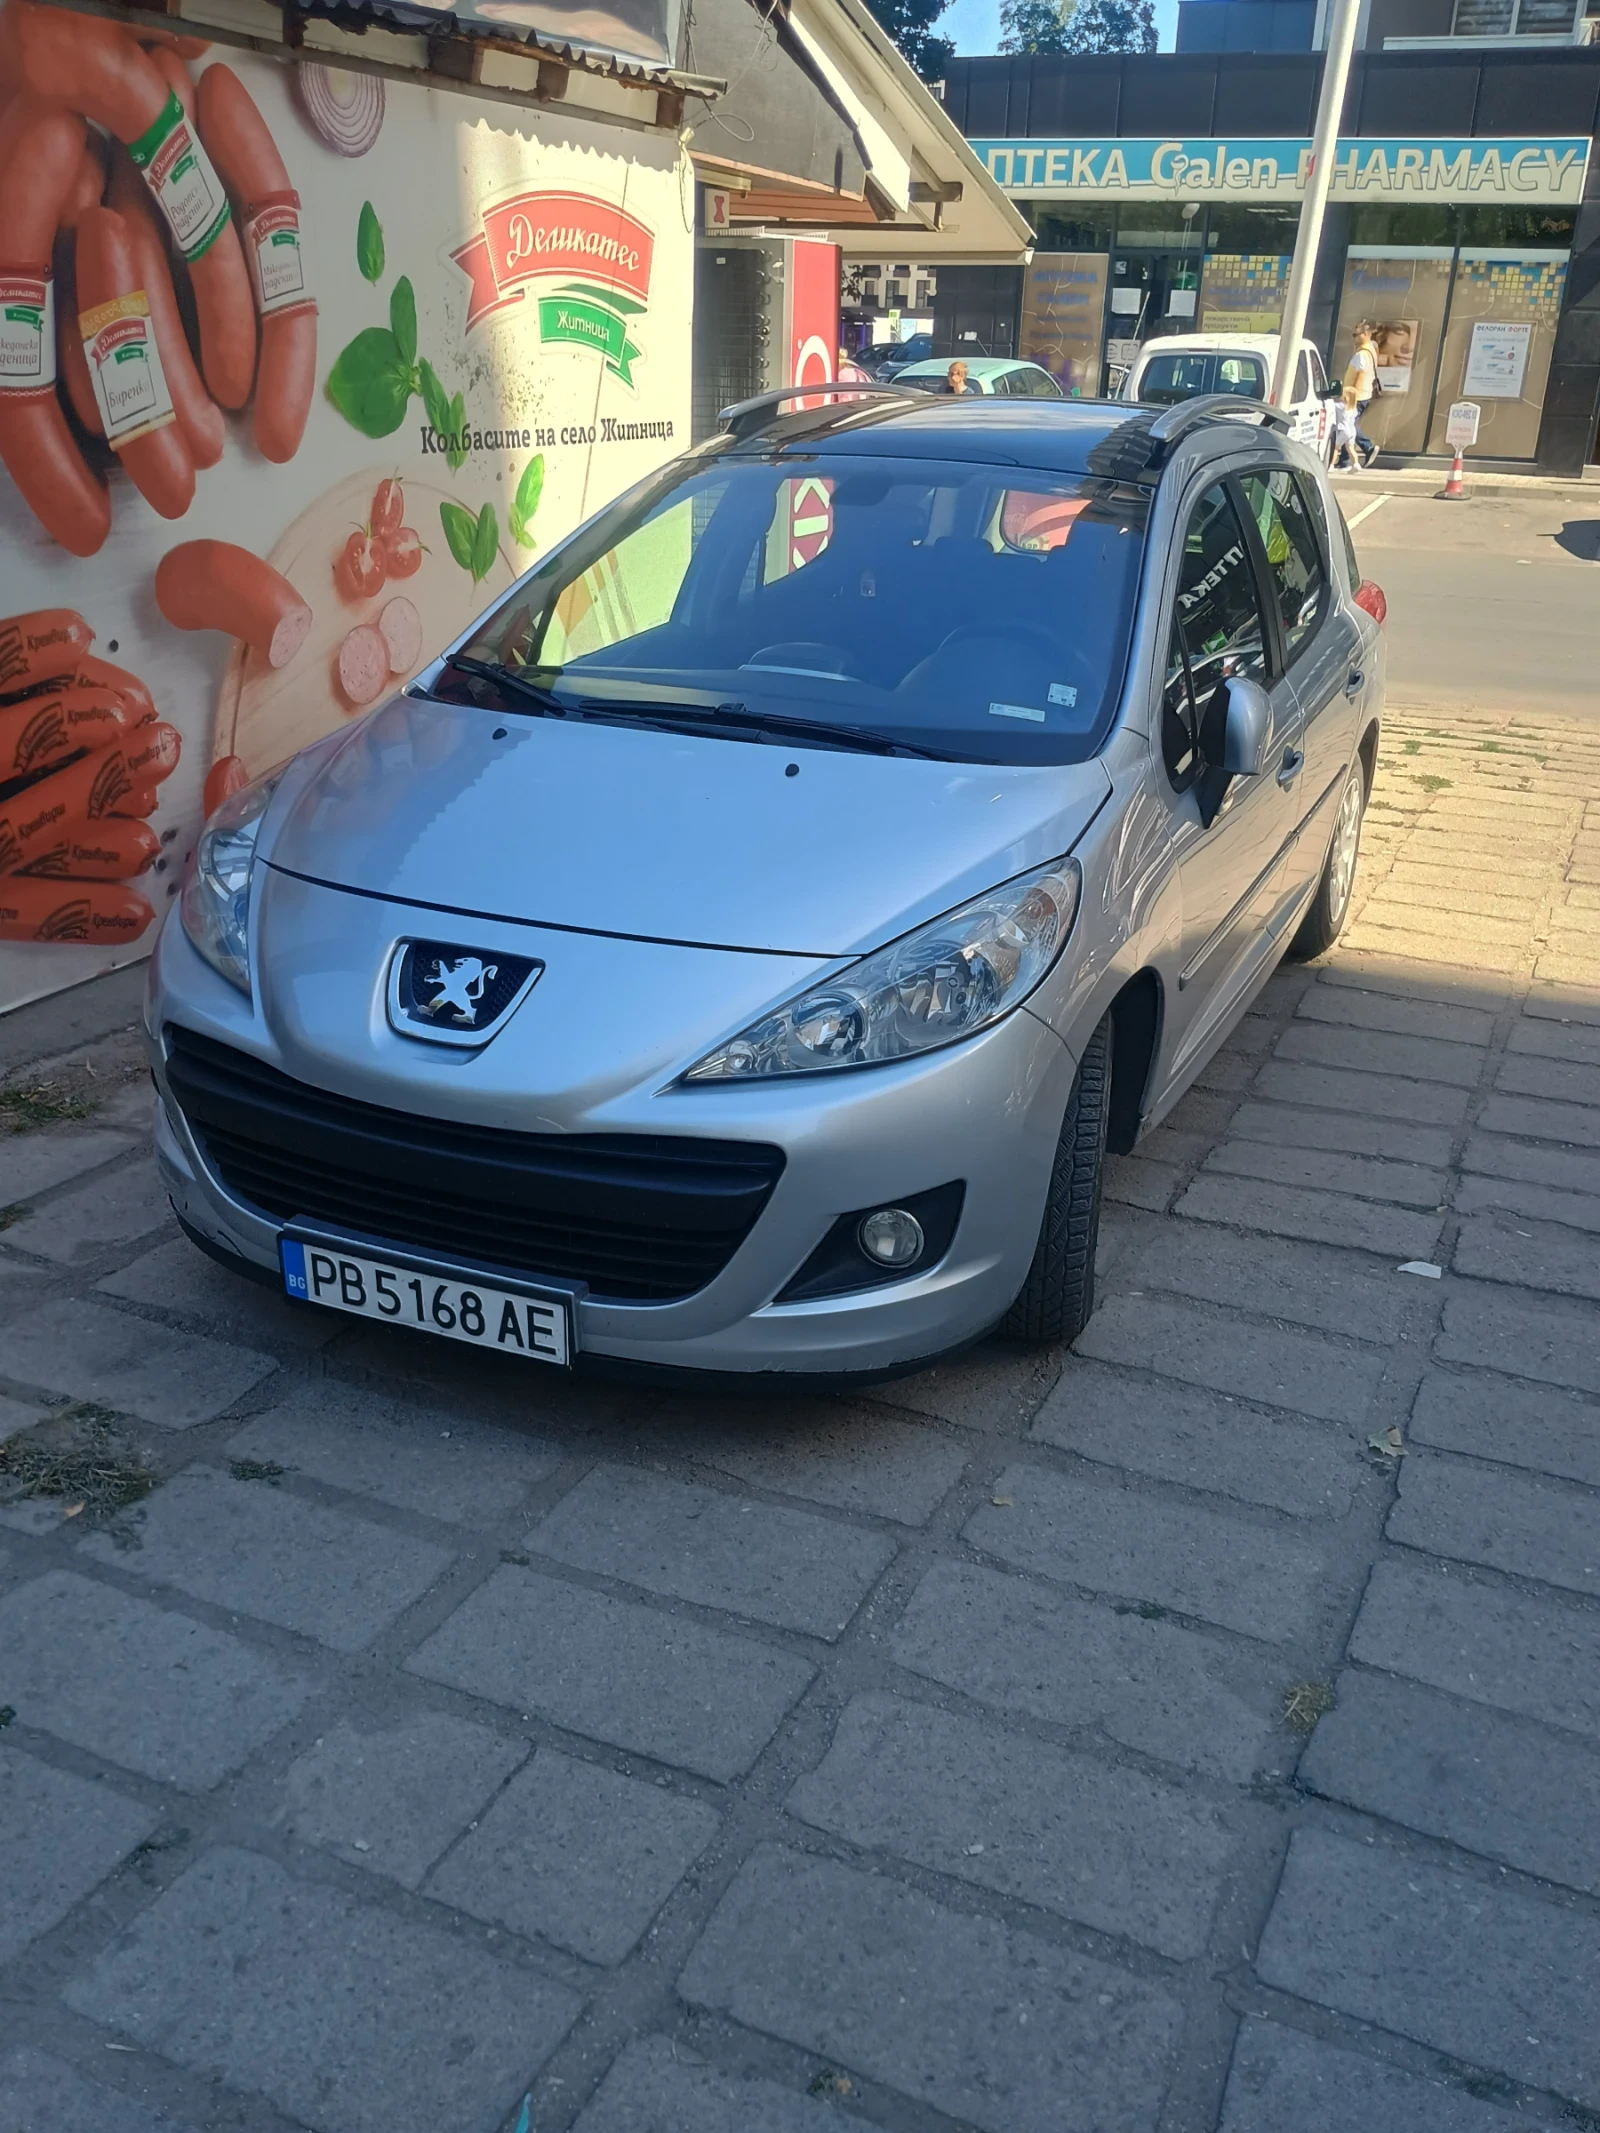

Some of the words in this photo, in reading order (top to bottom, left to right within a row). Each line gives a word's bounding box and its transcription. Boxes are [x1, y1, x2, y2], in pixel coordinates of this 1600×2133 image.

[988, 148, 1130, 189] ПТЕКА
[1151, 142, 1278, 192] Galen
[506, 213, 640, 272] Деликатес
[557, 310, 610, 342] Житница
[420, 424, 532, 455] Колбасите
[535, 427, 557, 448] на
[560, 424, 598, 446] село
[600, 417, 675, 444] Житница
[288, 1273, 306, 1290] BG
[376, 1268, 486, 1337] 5168
